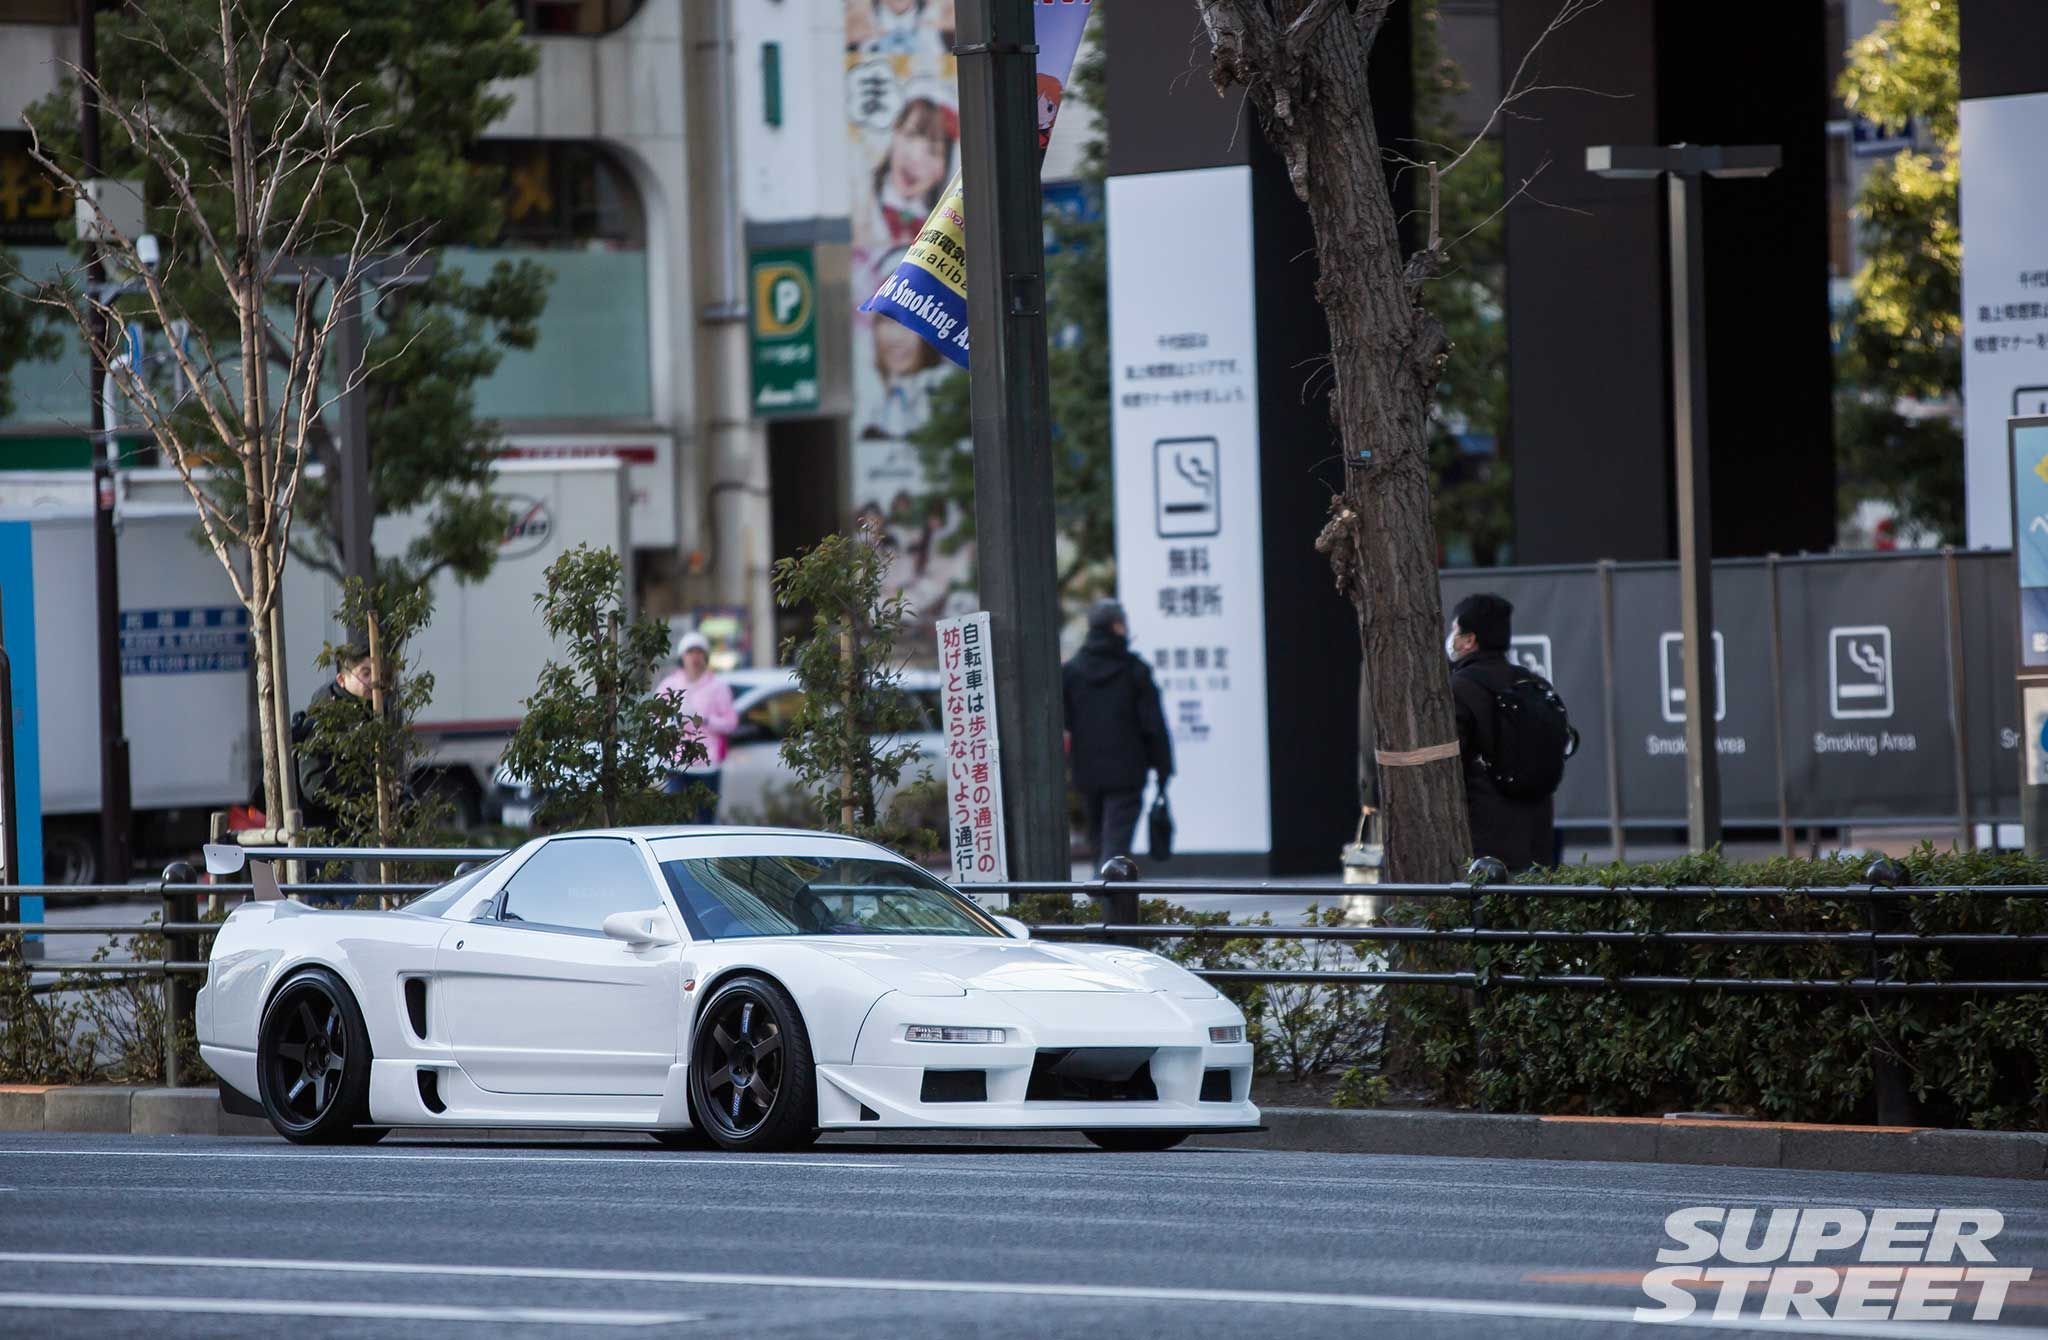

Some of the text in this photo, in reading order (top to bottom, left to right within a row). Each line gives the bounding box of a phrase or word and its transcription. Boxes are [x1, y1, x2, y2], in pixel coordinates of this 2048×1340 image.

[891, 278, 958, 340] Smoking
[963, 622, 996, 873] 自転車は歩行者の通行の
[1648, 735, 1687, 755] Smok
[1814, 732, 1917, 757] Smoking Area
